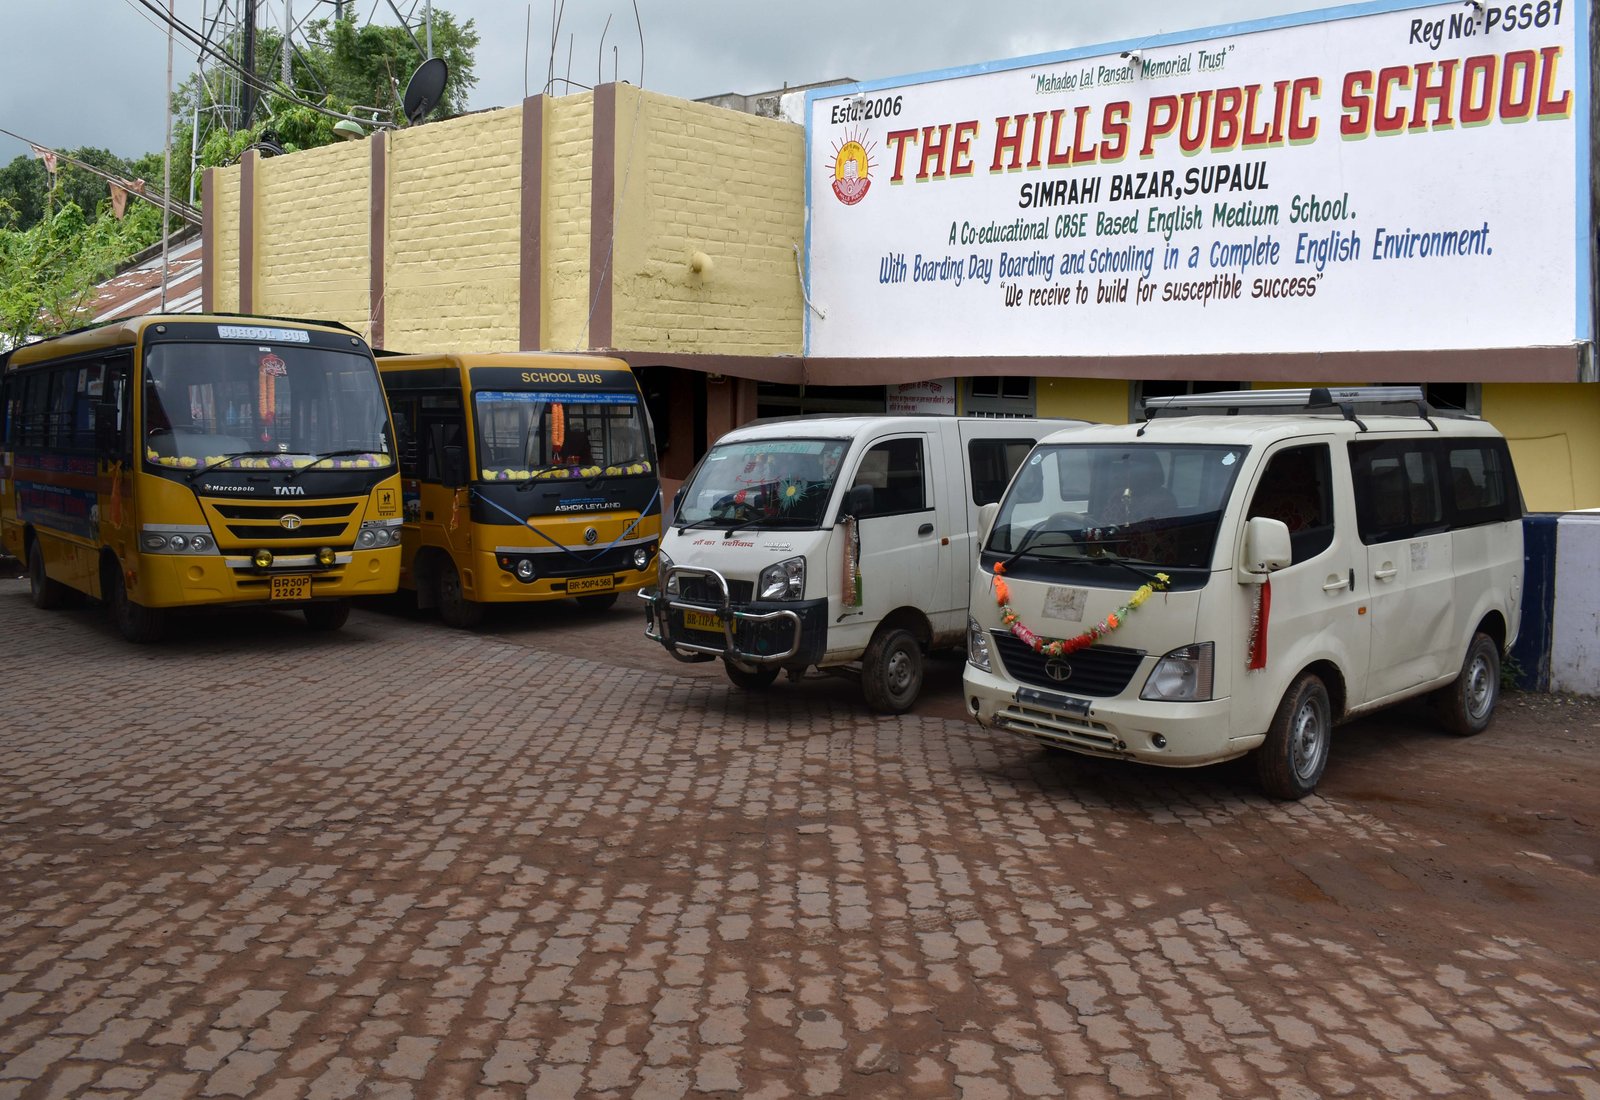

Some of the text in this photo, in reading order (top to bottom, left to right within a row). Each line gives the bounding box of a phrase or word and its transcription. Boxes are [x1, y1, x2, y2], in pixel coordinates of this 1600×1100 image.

[1409, 18, 1446, 50] Reg
[1079, 67, 1094, 88] Lal
[1140, 53, 1191, 79] Memorial
[886, 45, 1574, 185] THE HILLS PUBLIC SCHOOL
[1018, 176, 1102, 208] SIMRAHI
[948, 193, 1357, 246] A Co-educational CBSE Based English Medium School.
[879, 252, 907, 284] With
[998, 250, 1055, 281] Boarding
[1060, 250, 1086, 275] and
[1088, 245, 1155, 280] Schooling
[1163, 242, 1179, 270] in
[1187, 245, 1200, 269] a
[1209, 234, 1281, 274] Complete
[1295, 230, 1361, 272] English
[1372, 222, 1493, 260] Environment.
[1028, 283, 1070, 306] receive
[1075, 281, 1088, 304] to
[1097, 278, 1129, 304] build
[1136, 276, 1157, 306] for
[1162, 273, 1242, 307] susceptible
[220, 327, 309, 342] SCHOOL BUS
[521, 372, 603, 384] SCHOOL BUS
[212, 485, 255, 493] Marcopolo
[273, 486, 305, 495] TATA
[555, 502, 621, 512] ASHOK LEYLAND
[273, 578, 310, 588] BR50P
[275, 588, 302, 598] 2262
